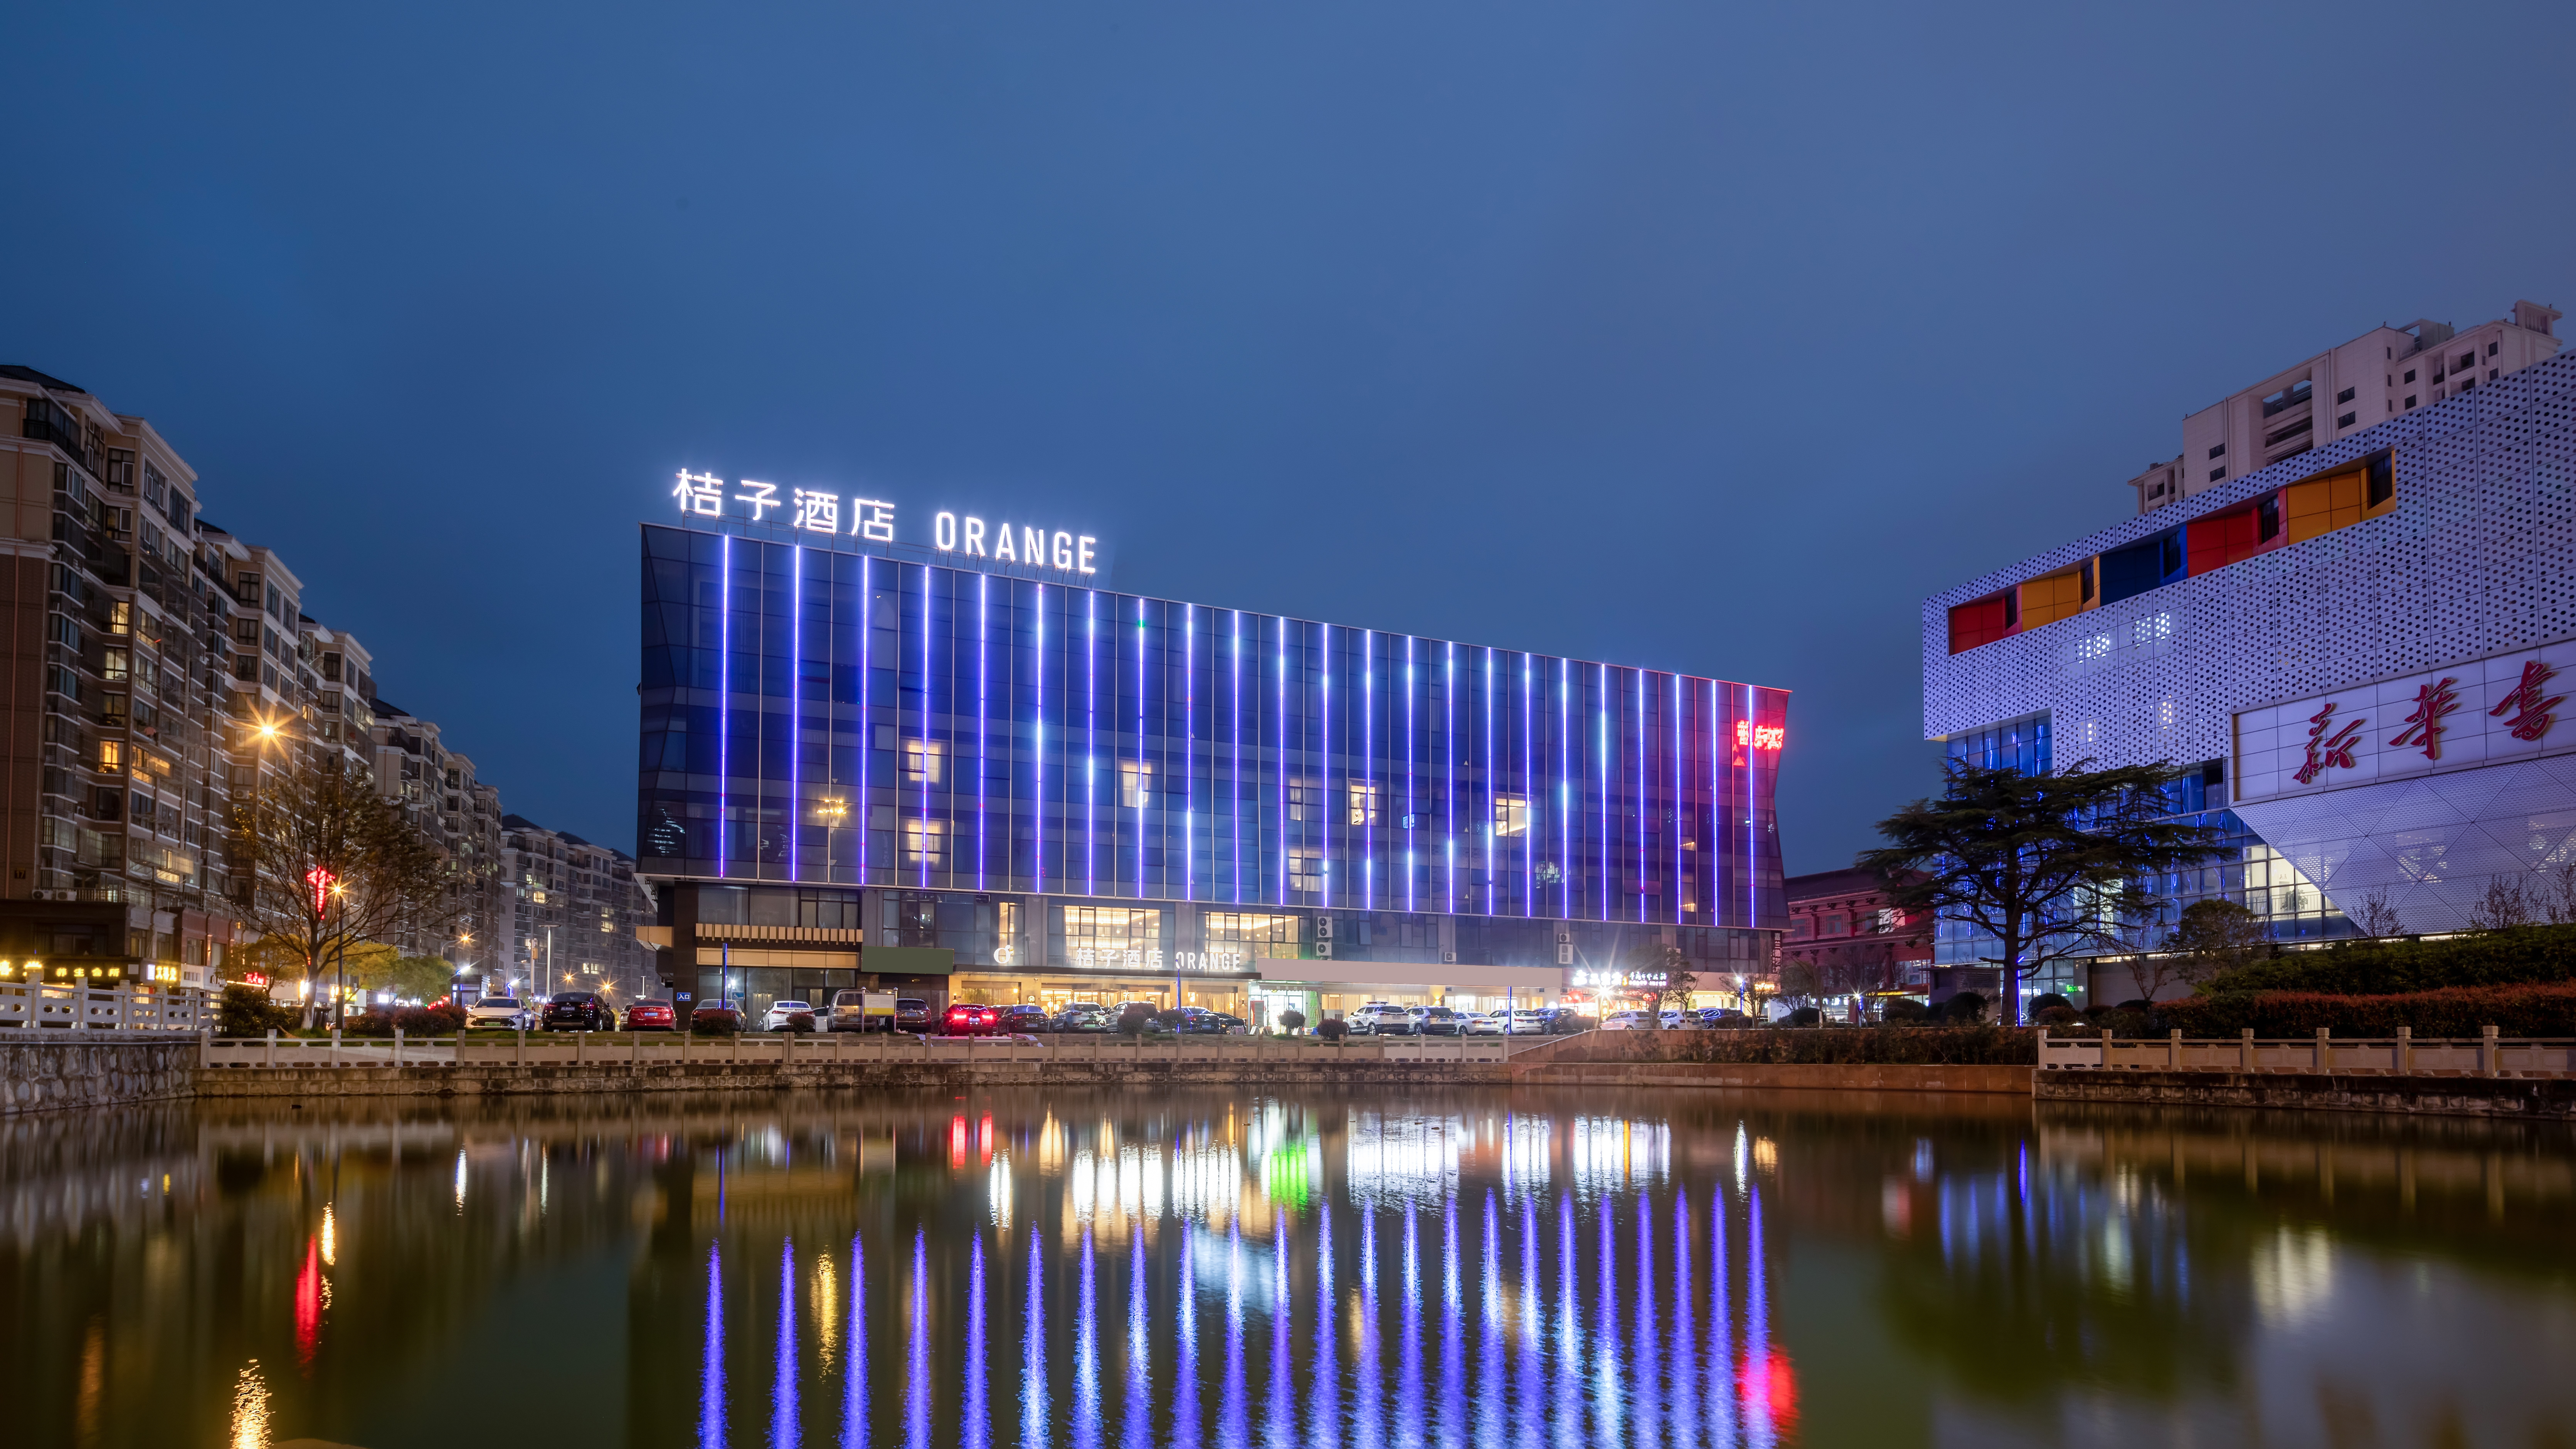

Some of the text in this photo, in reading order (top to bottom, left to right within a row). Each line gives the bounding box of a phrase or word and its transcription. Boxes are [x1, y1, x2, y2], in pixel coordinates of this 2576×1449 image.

[673, 468, 1095, 573] 桔子酒店 ORANGE
[1076, 947, 1241, 971] 桔子酒店 ORANGE
